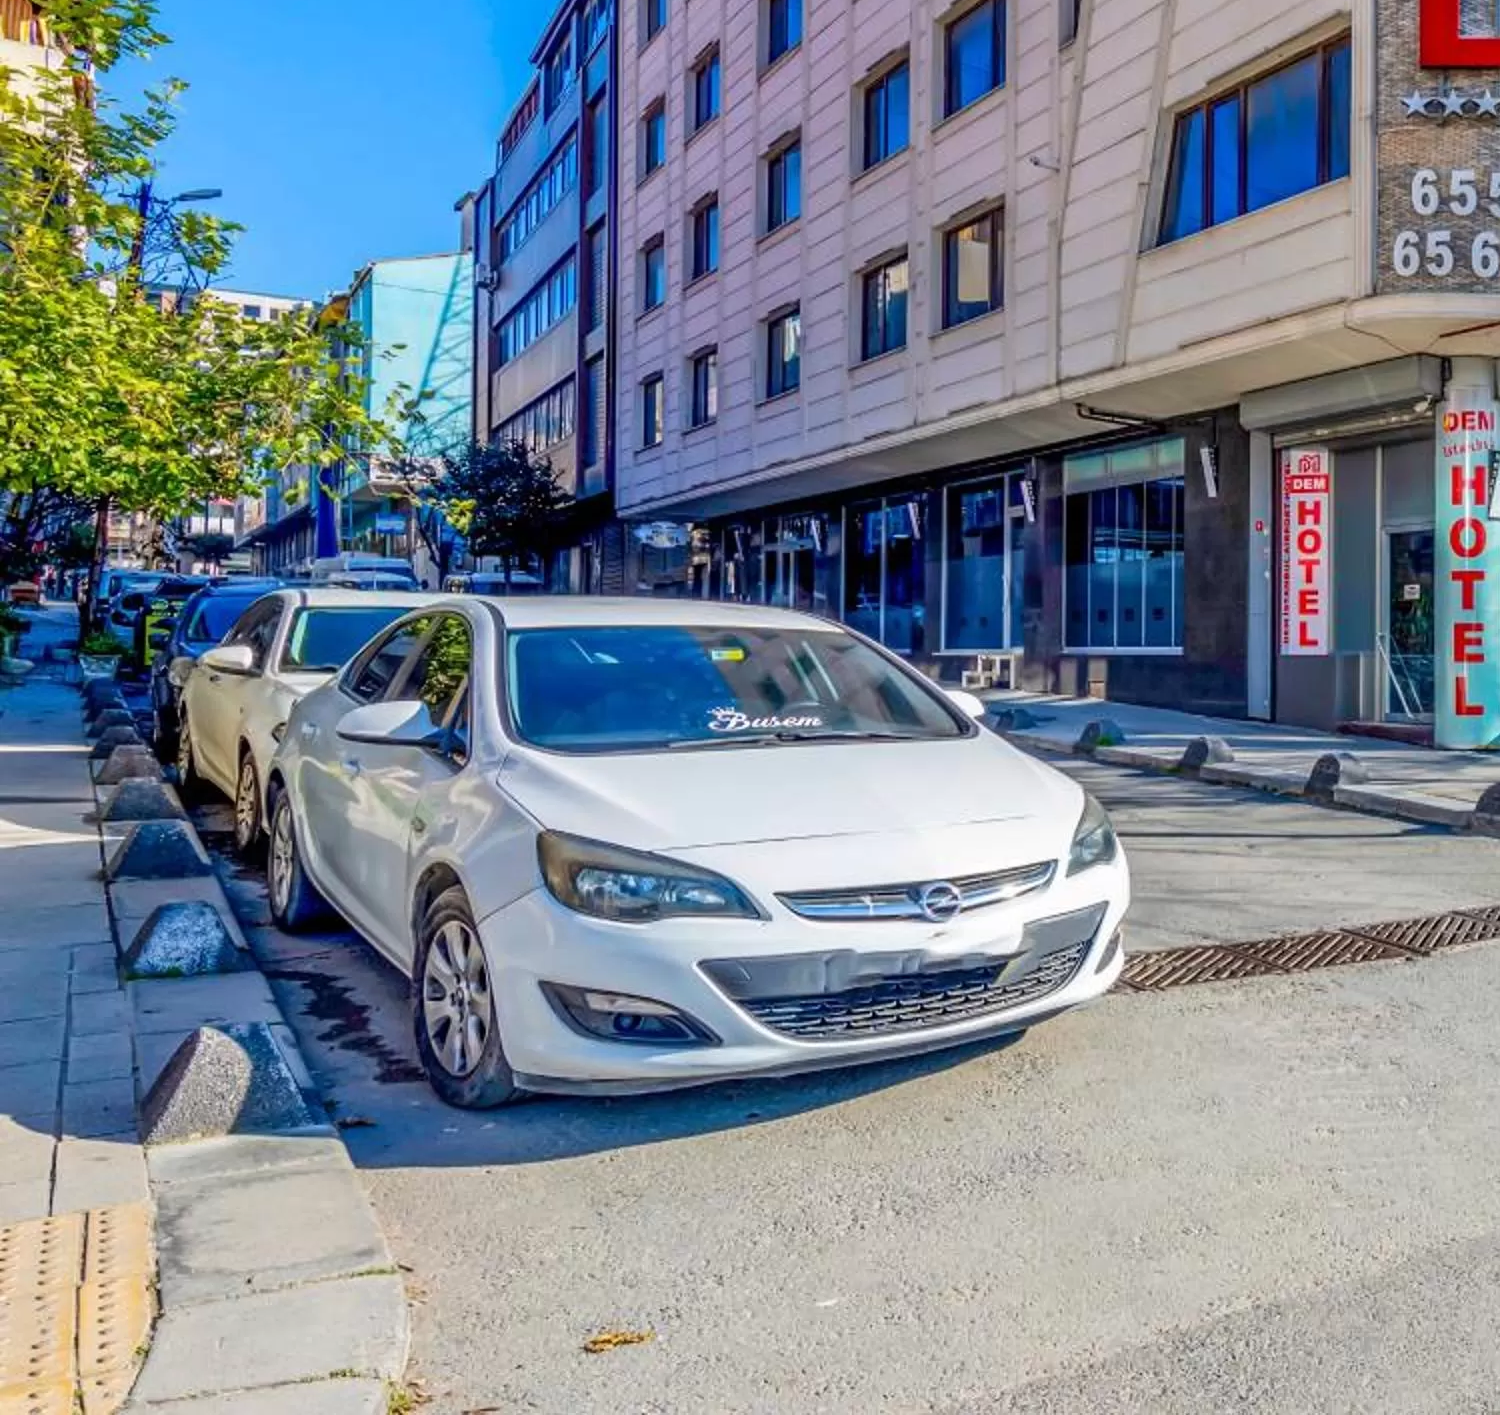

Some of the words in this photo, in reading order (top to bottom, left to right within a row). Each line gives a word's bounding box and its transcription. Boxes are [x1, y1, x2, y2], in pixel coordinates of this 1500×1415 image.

[1393, 230, 1454, 277] 65
[1442, 410, 1495, 433] DEM
[1292, 477, 1327, 490] DEM
[1296, 500, 1323, 647] HOTEL
[1449, 465, 1487, 716] HOTEL
